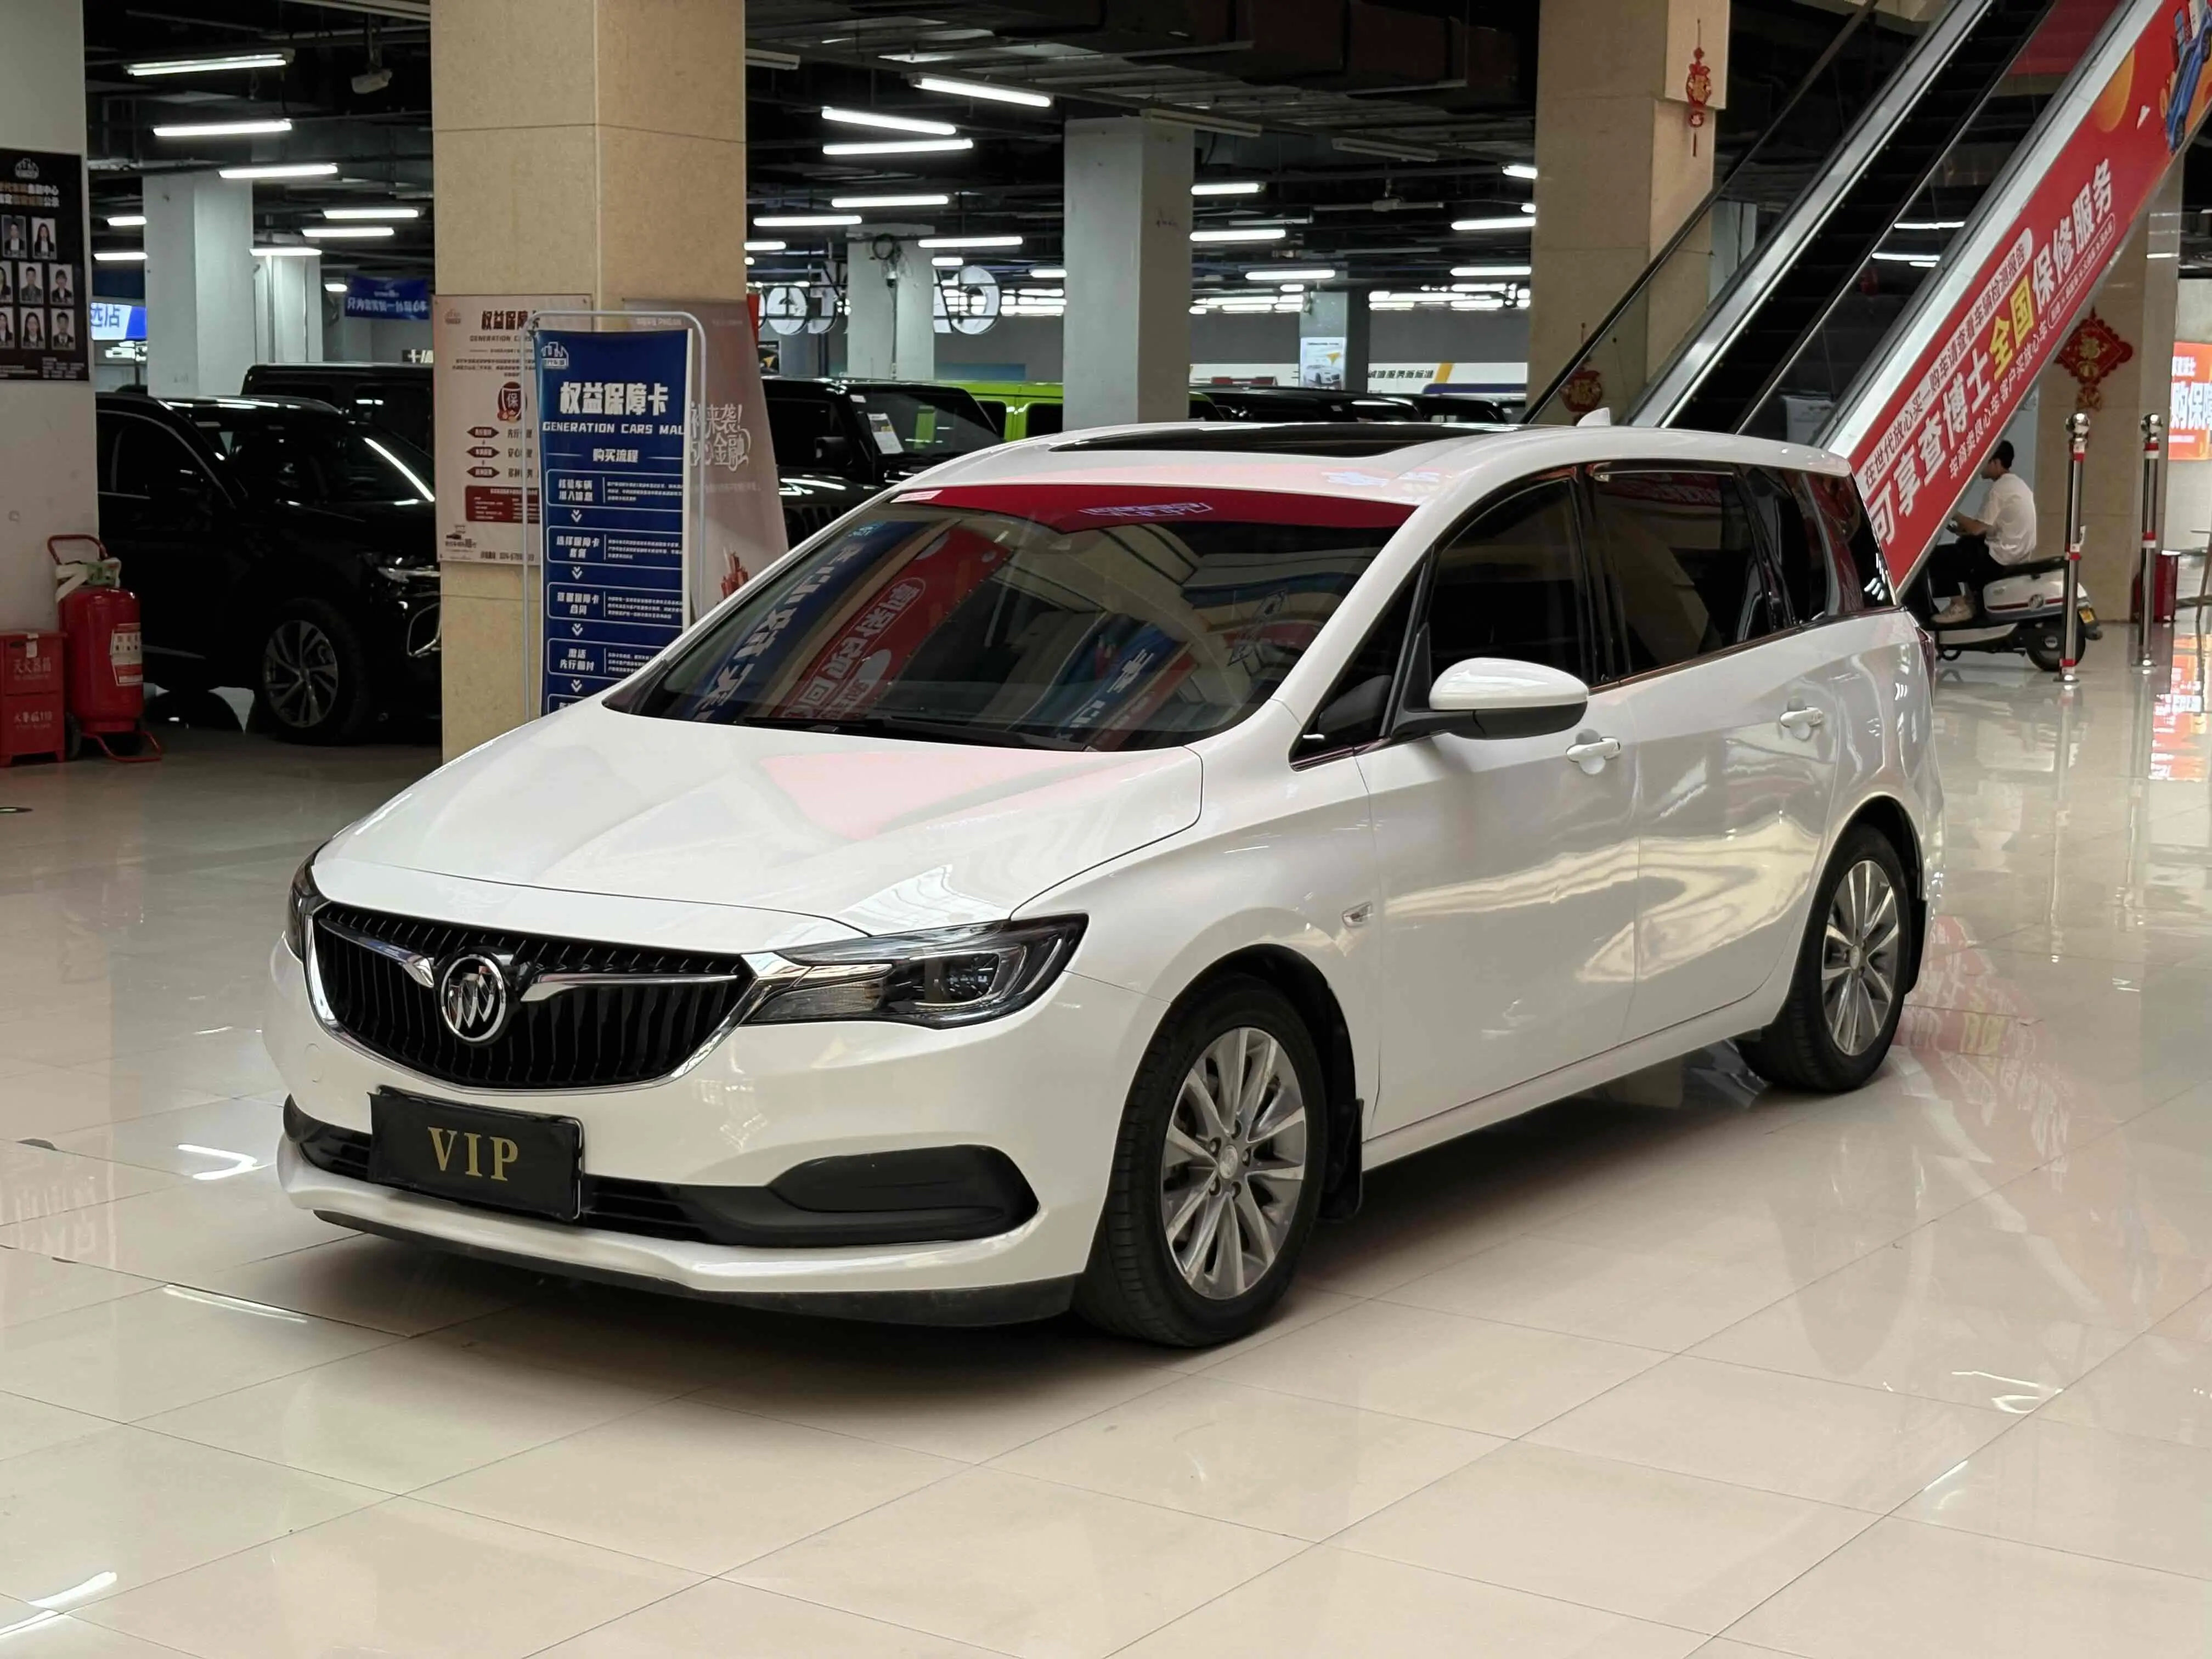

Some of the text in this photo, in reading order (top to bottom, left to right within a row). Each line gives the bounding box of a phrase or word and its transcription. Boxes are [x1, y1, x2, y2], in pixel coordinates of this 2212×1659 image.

[1869, 157, 2113, 544] 可享查博士全国保修服务
[560, 381, 669, 416] 权益保障卡
[542, 421, 615, 433] GENERATION
[620, 424, 653, 434] CARS
[592, 448, 639, 464] 购买流程
[427, 1126, 519, 1182] VIP
